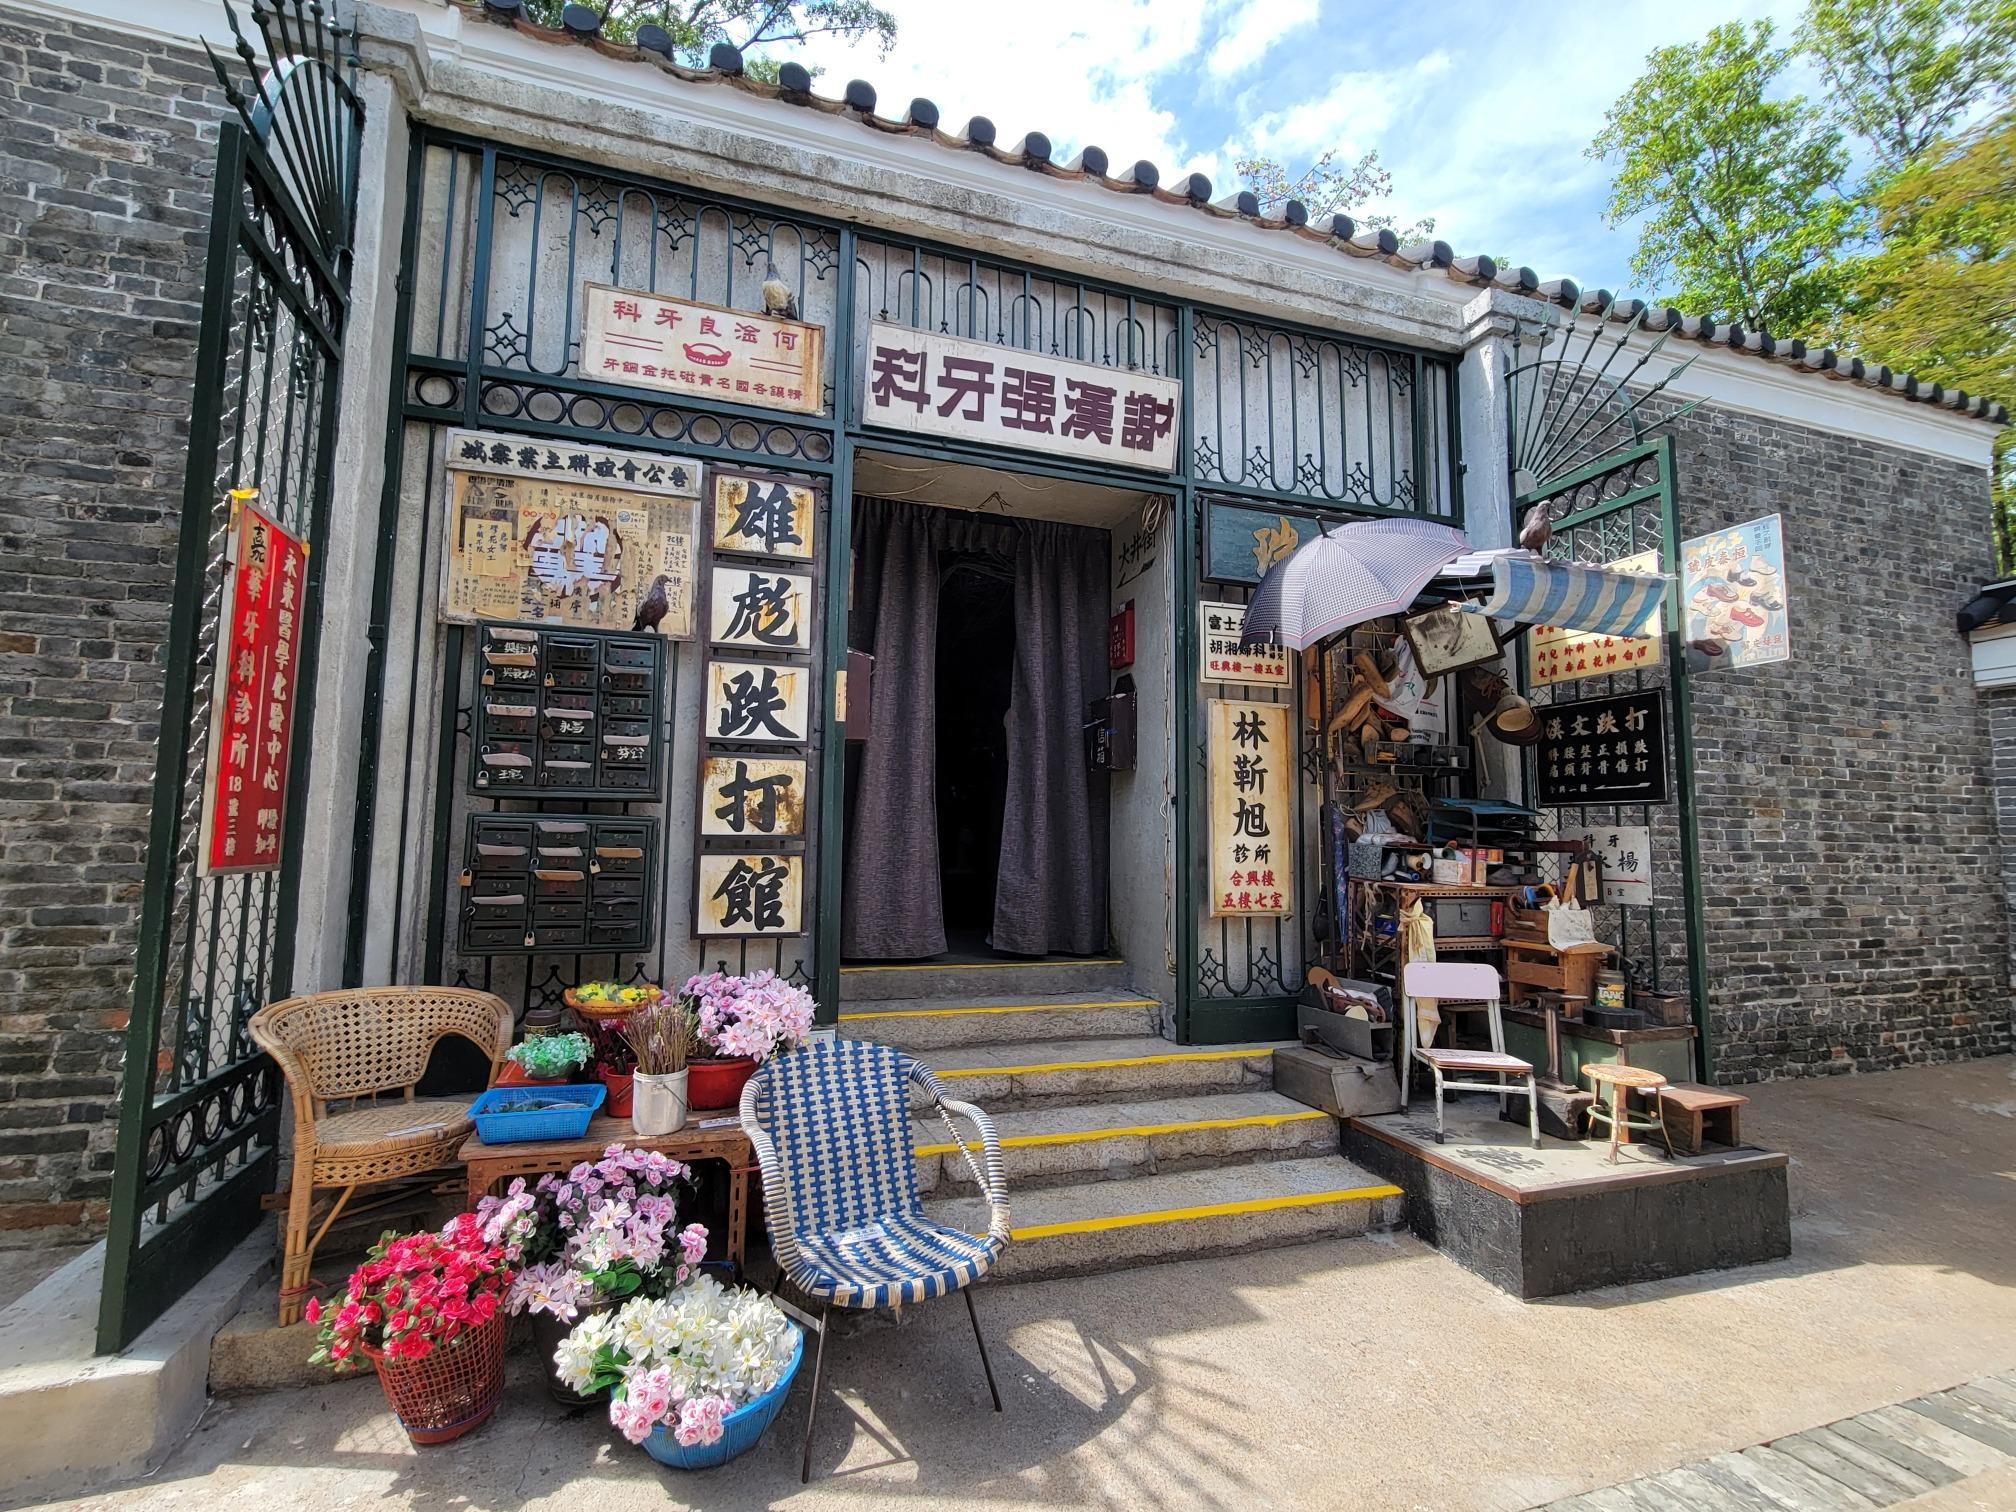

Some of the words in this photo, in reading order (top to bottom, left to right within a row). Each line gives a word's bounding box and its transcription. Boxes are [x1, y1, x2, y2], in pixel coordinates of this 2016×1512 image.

[228, 775, 242, 793] 18
[1231, 710, 1271, 838] 林靳旭
[1232, 843, 1271, 865] 診所
